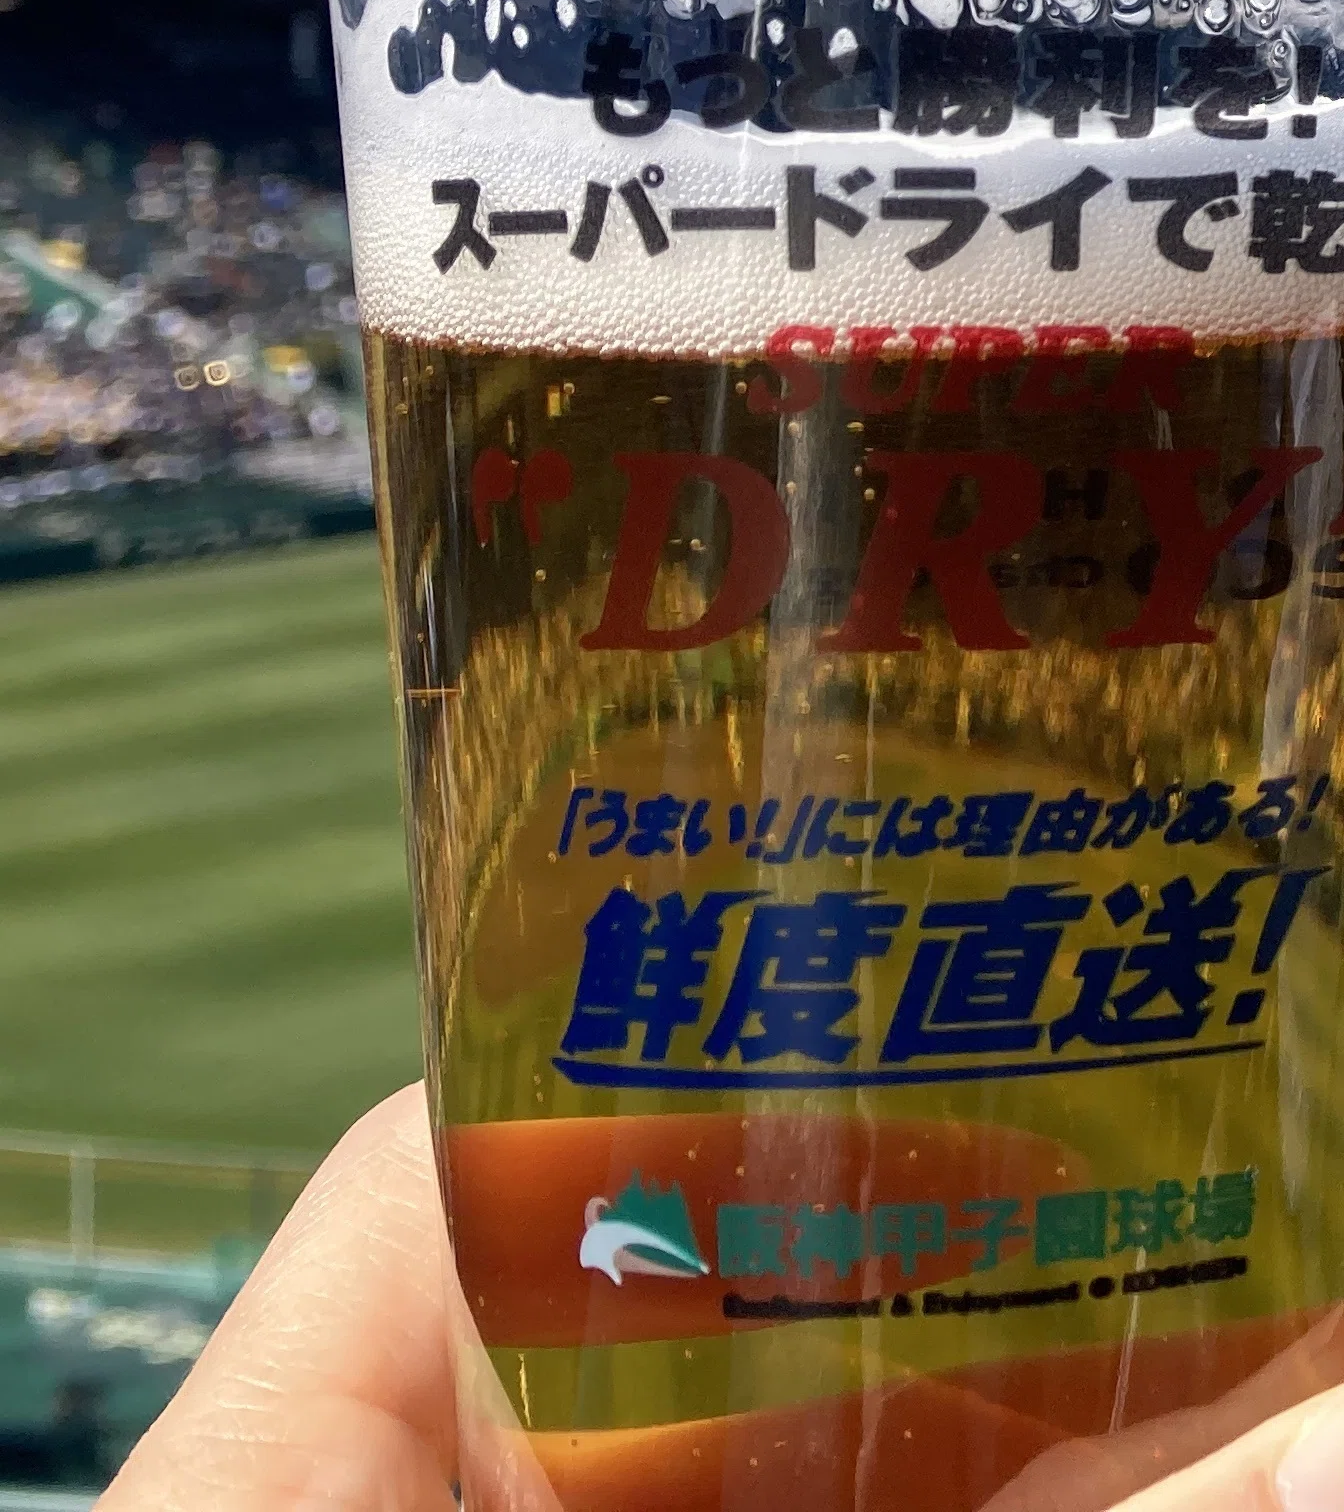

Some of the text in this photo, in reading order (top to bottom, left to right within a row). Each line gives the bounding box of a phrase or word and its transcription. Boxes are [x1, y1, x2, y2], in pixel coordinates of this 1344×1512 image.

[747, 324, 1200, 415] SUPER
[556, 774, 1331, 865] 「うまい!」には理由がある!
[558, 865, 1335, 1066] 鮮度直送!
[715, 1172, 1257, 1279] 阪神甲子園球場
